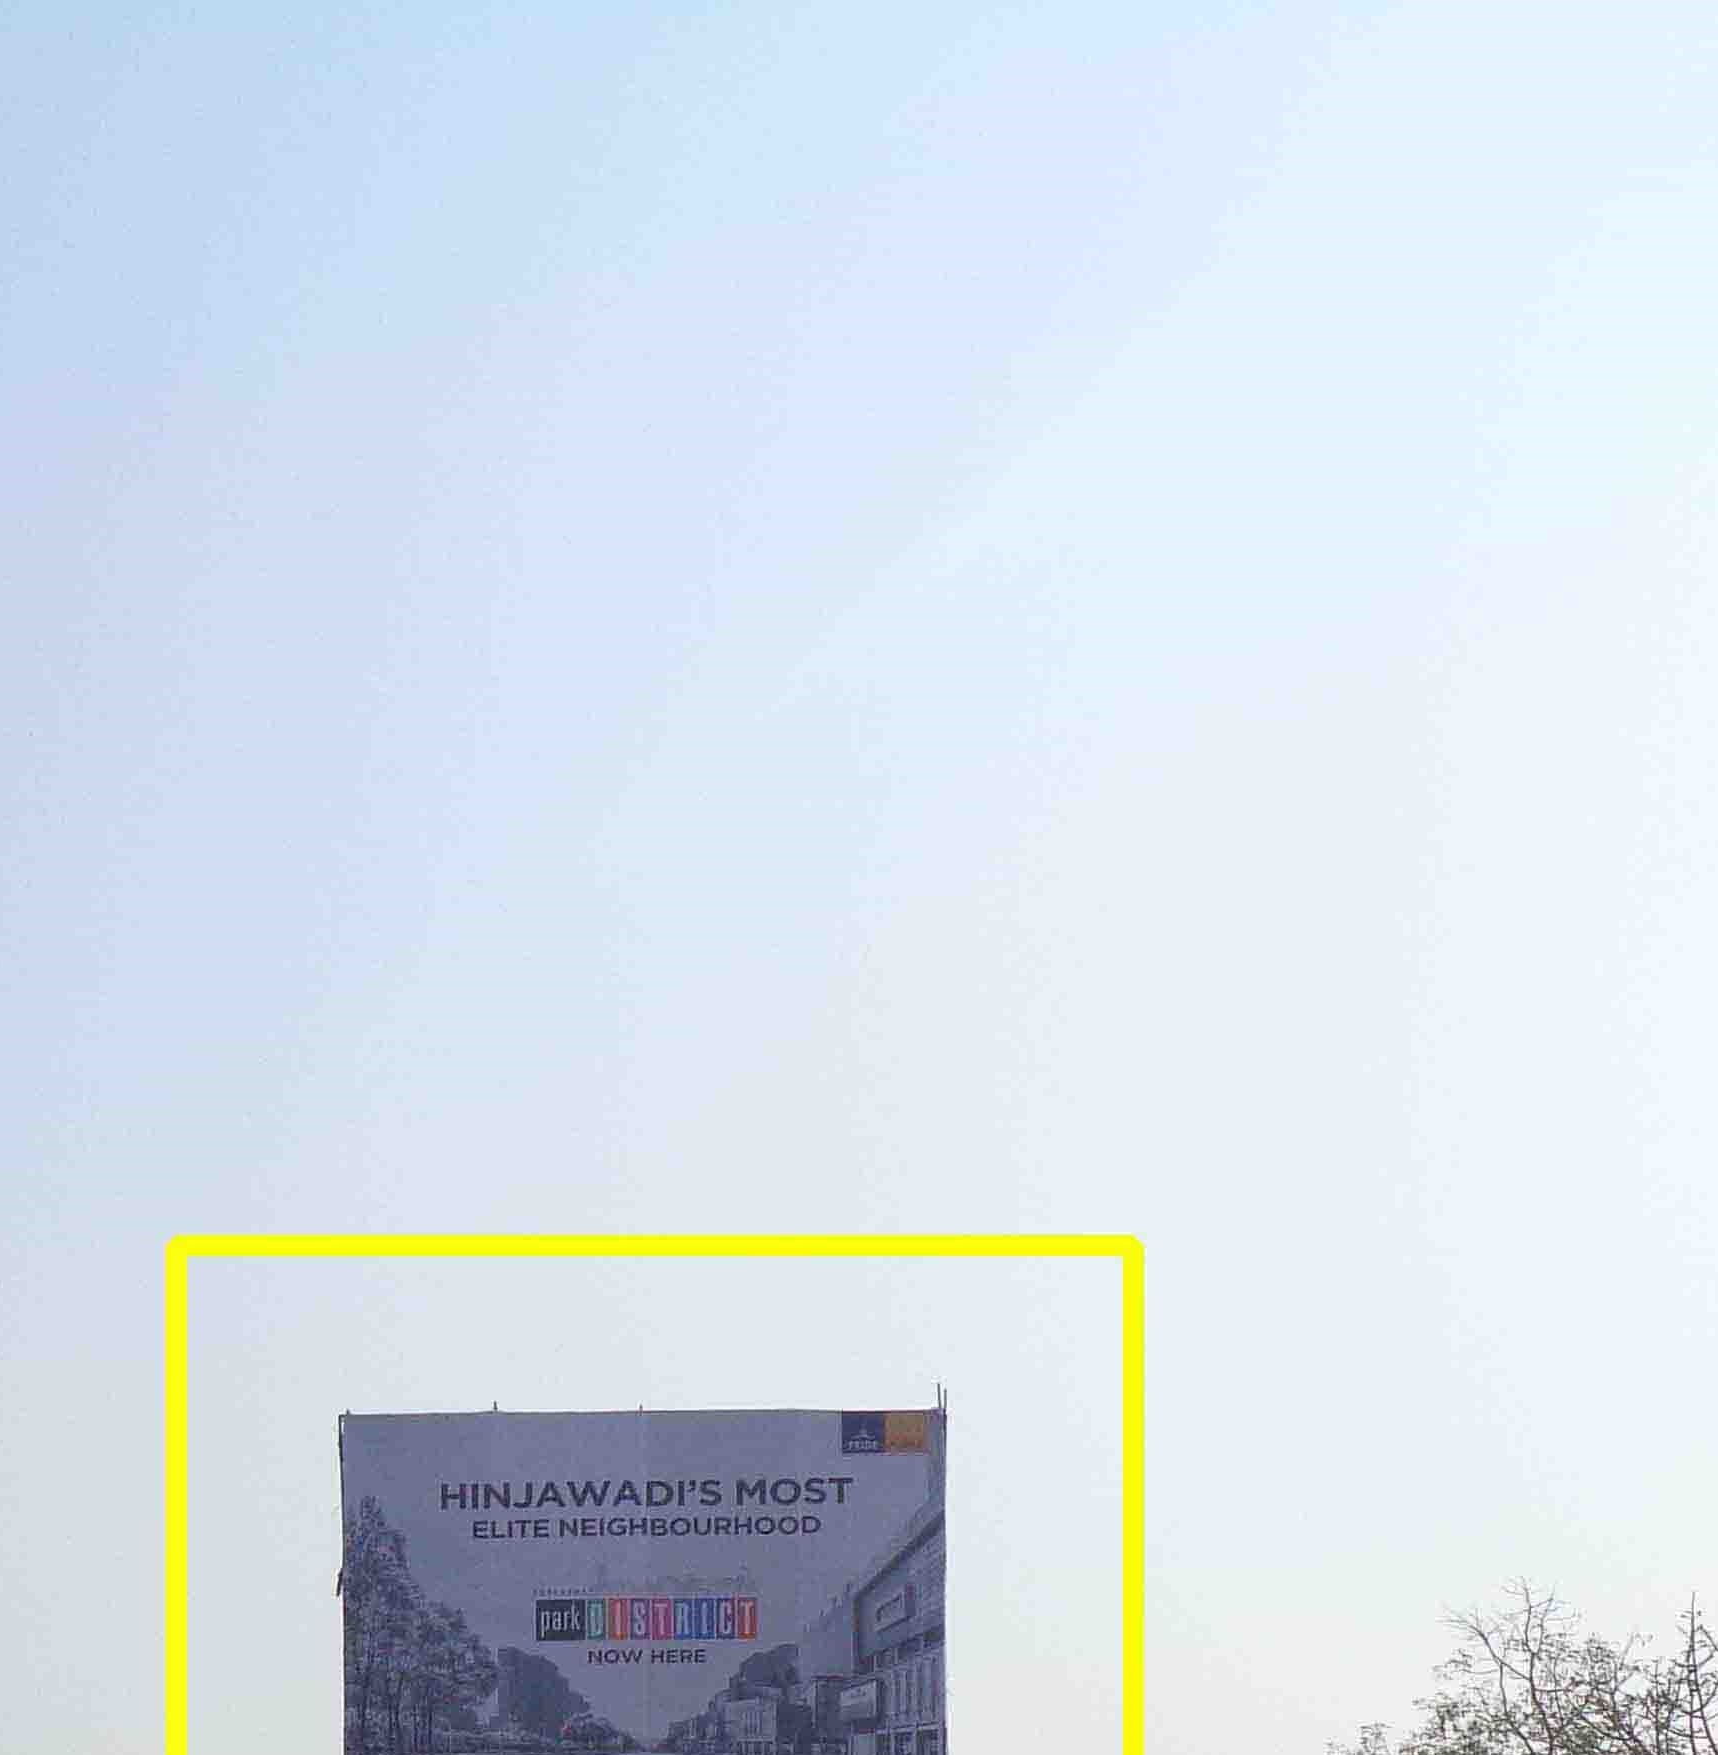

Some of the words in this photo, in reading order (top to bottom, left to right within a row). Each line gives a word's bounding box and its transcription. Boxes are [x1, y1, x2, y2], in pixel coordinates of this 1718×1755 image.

[440, 1480, 723, 1511] HINJAWADI'S
[736, 1477, 854, 1506] MOST
[472, 1520, 549, 1539] ELITE
[559, 1516, 821, 1537] NEIGHBOURHOOD
[540, 1605, 581, 1638] park
[588, 1601, 757, 1640] DISTRICT
[588, 1649, 642, 1664] NOW
[651, 1649, 706, 1664] HERE
